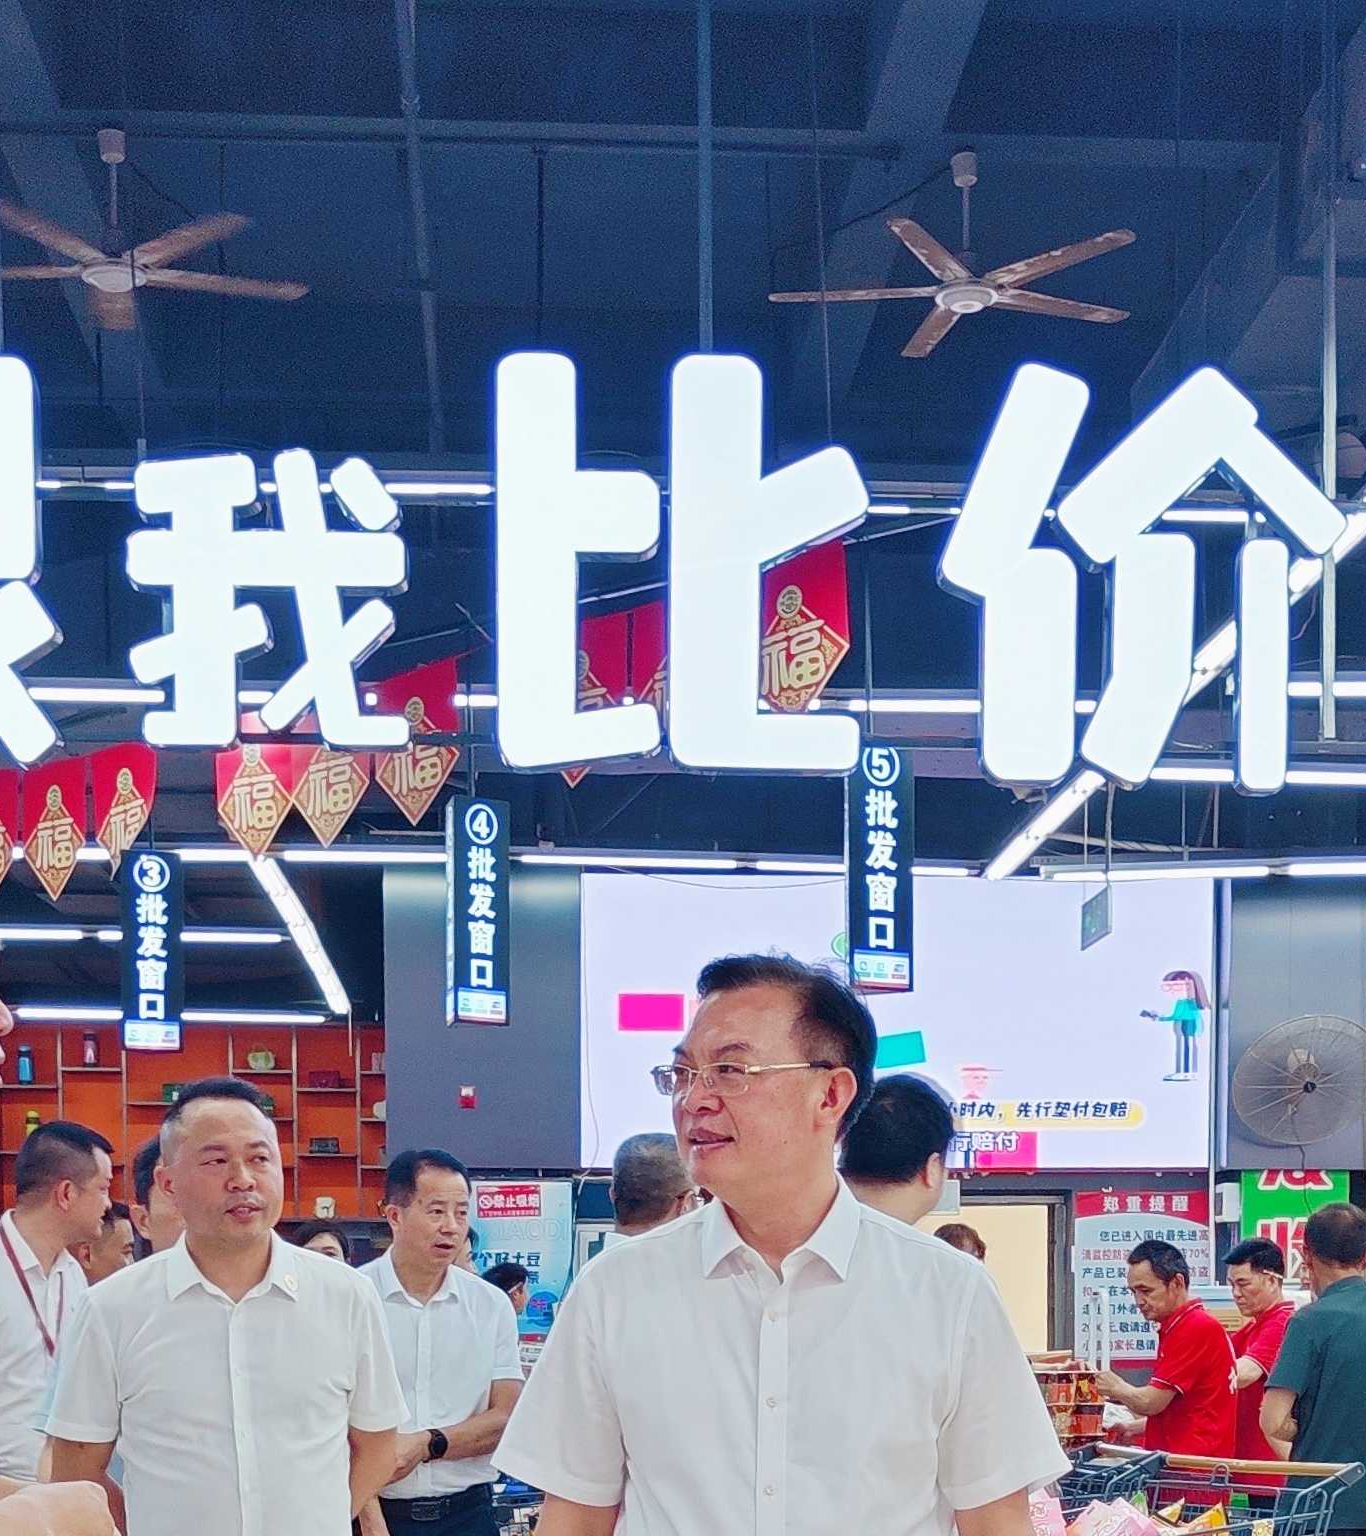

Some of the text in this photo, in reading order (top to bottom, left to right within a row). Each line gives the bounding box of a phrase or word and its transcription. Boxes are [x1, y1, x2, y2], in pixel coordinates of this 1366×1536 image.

[761, 618, 826, 697] 福
[307, 752, 354, 818] 福
[394, 744, 447, 794] 福
[108, 797, 146, 849] 福
[232, 772, 278, 833] 福
[36, 817, 75, 870] 福
[492, 1194, 540, 1208] 禁止吸烟
[1102, 1195, 1190, 1213] 郑重提醒
[1099, 1229, 1210, 1243] 您已进入国内最先进高
